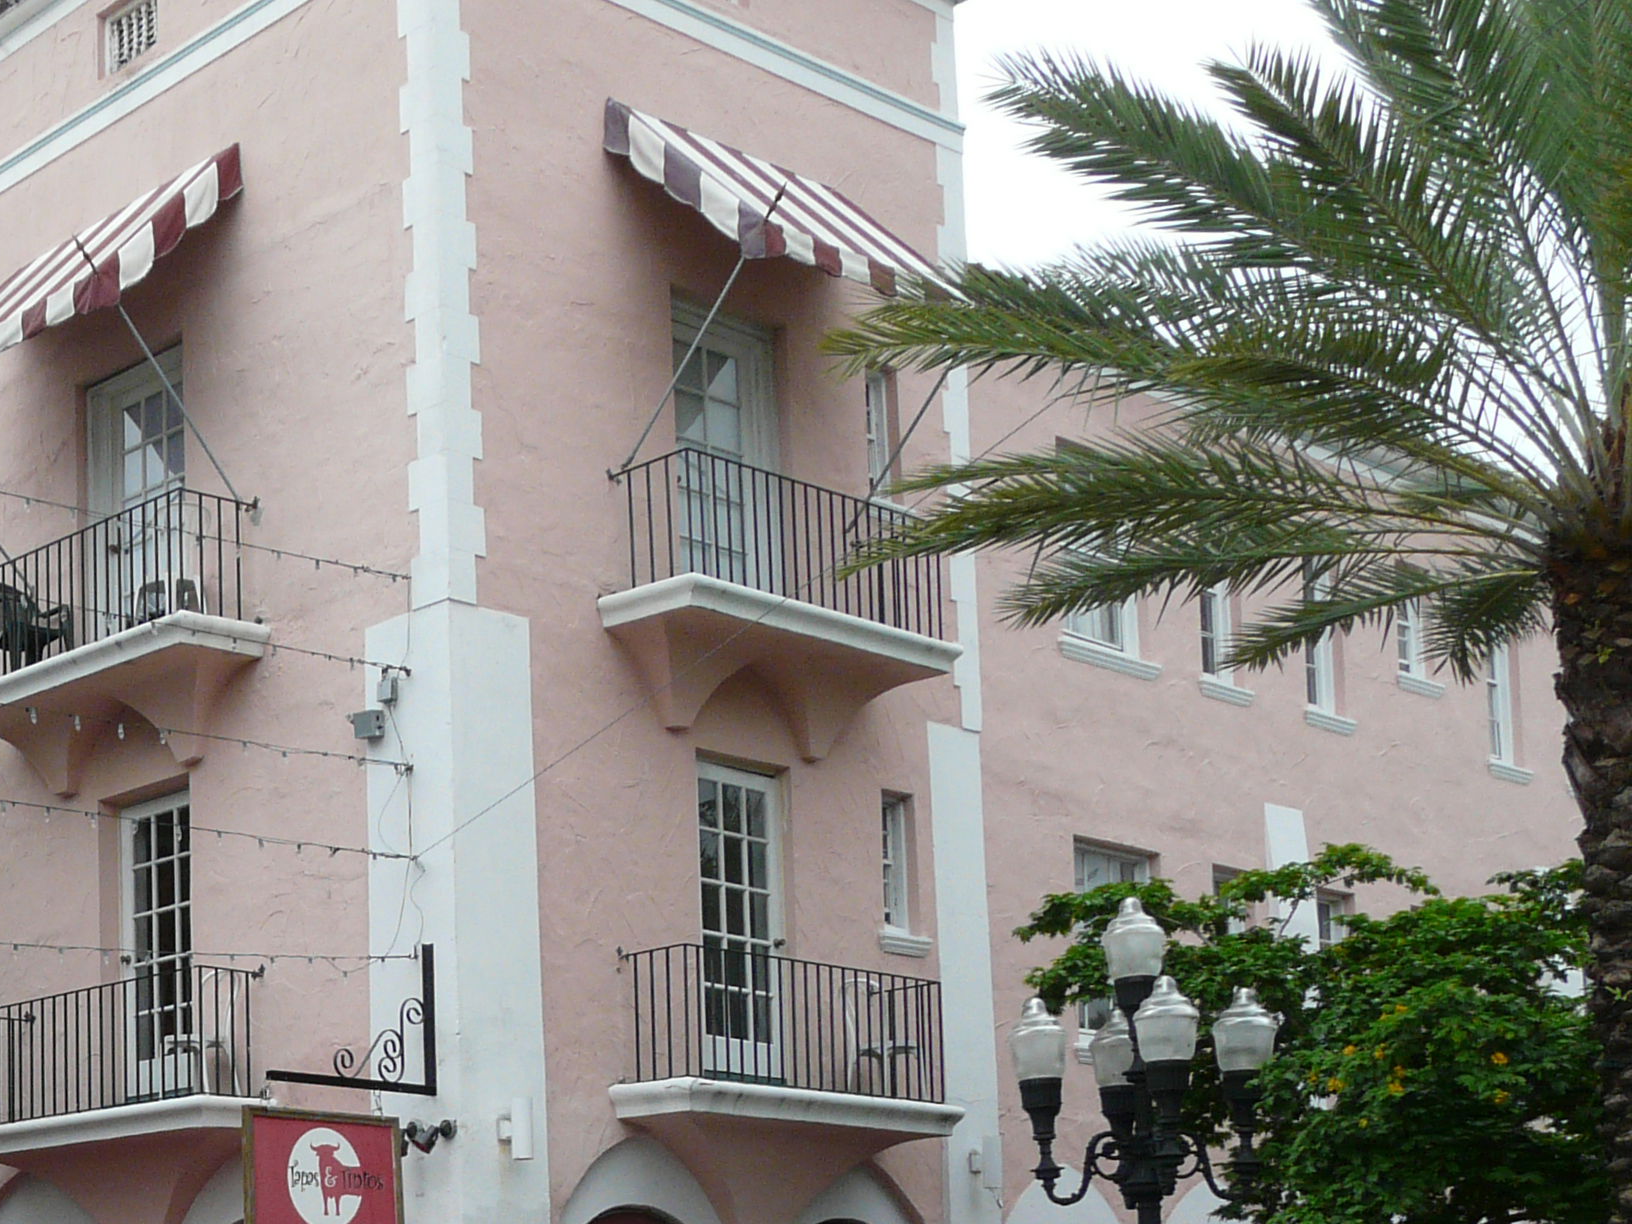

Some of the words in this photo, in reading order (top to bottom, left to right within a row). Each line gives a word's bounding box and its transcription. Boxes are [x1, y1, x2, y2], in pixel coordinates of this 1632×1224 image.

[289, 1160, 320, 1192] Tapas
[324, 1166, 338, 1188] &
[341, 1168, 385, 1191] Tintos
